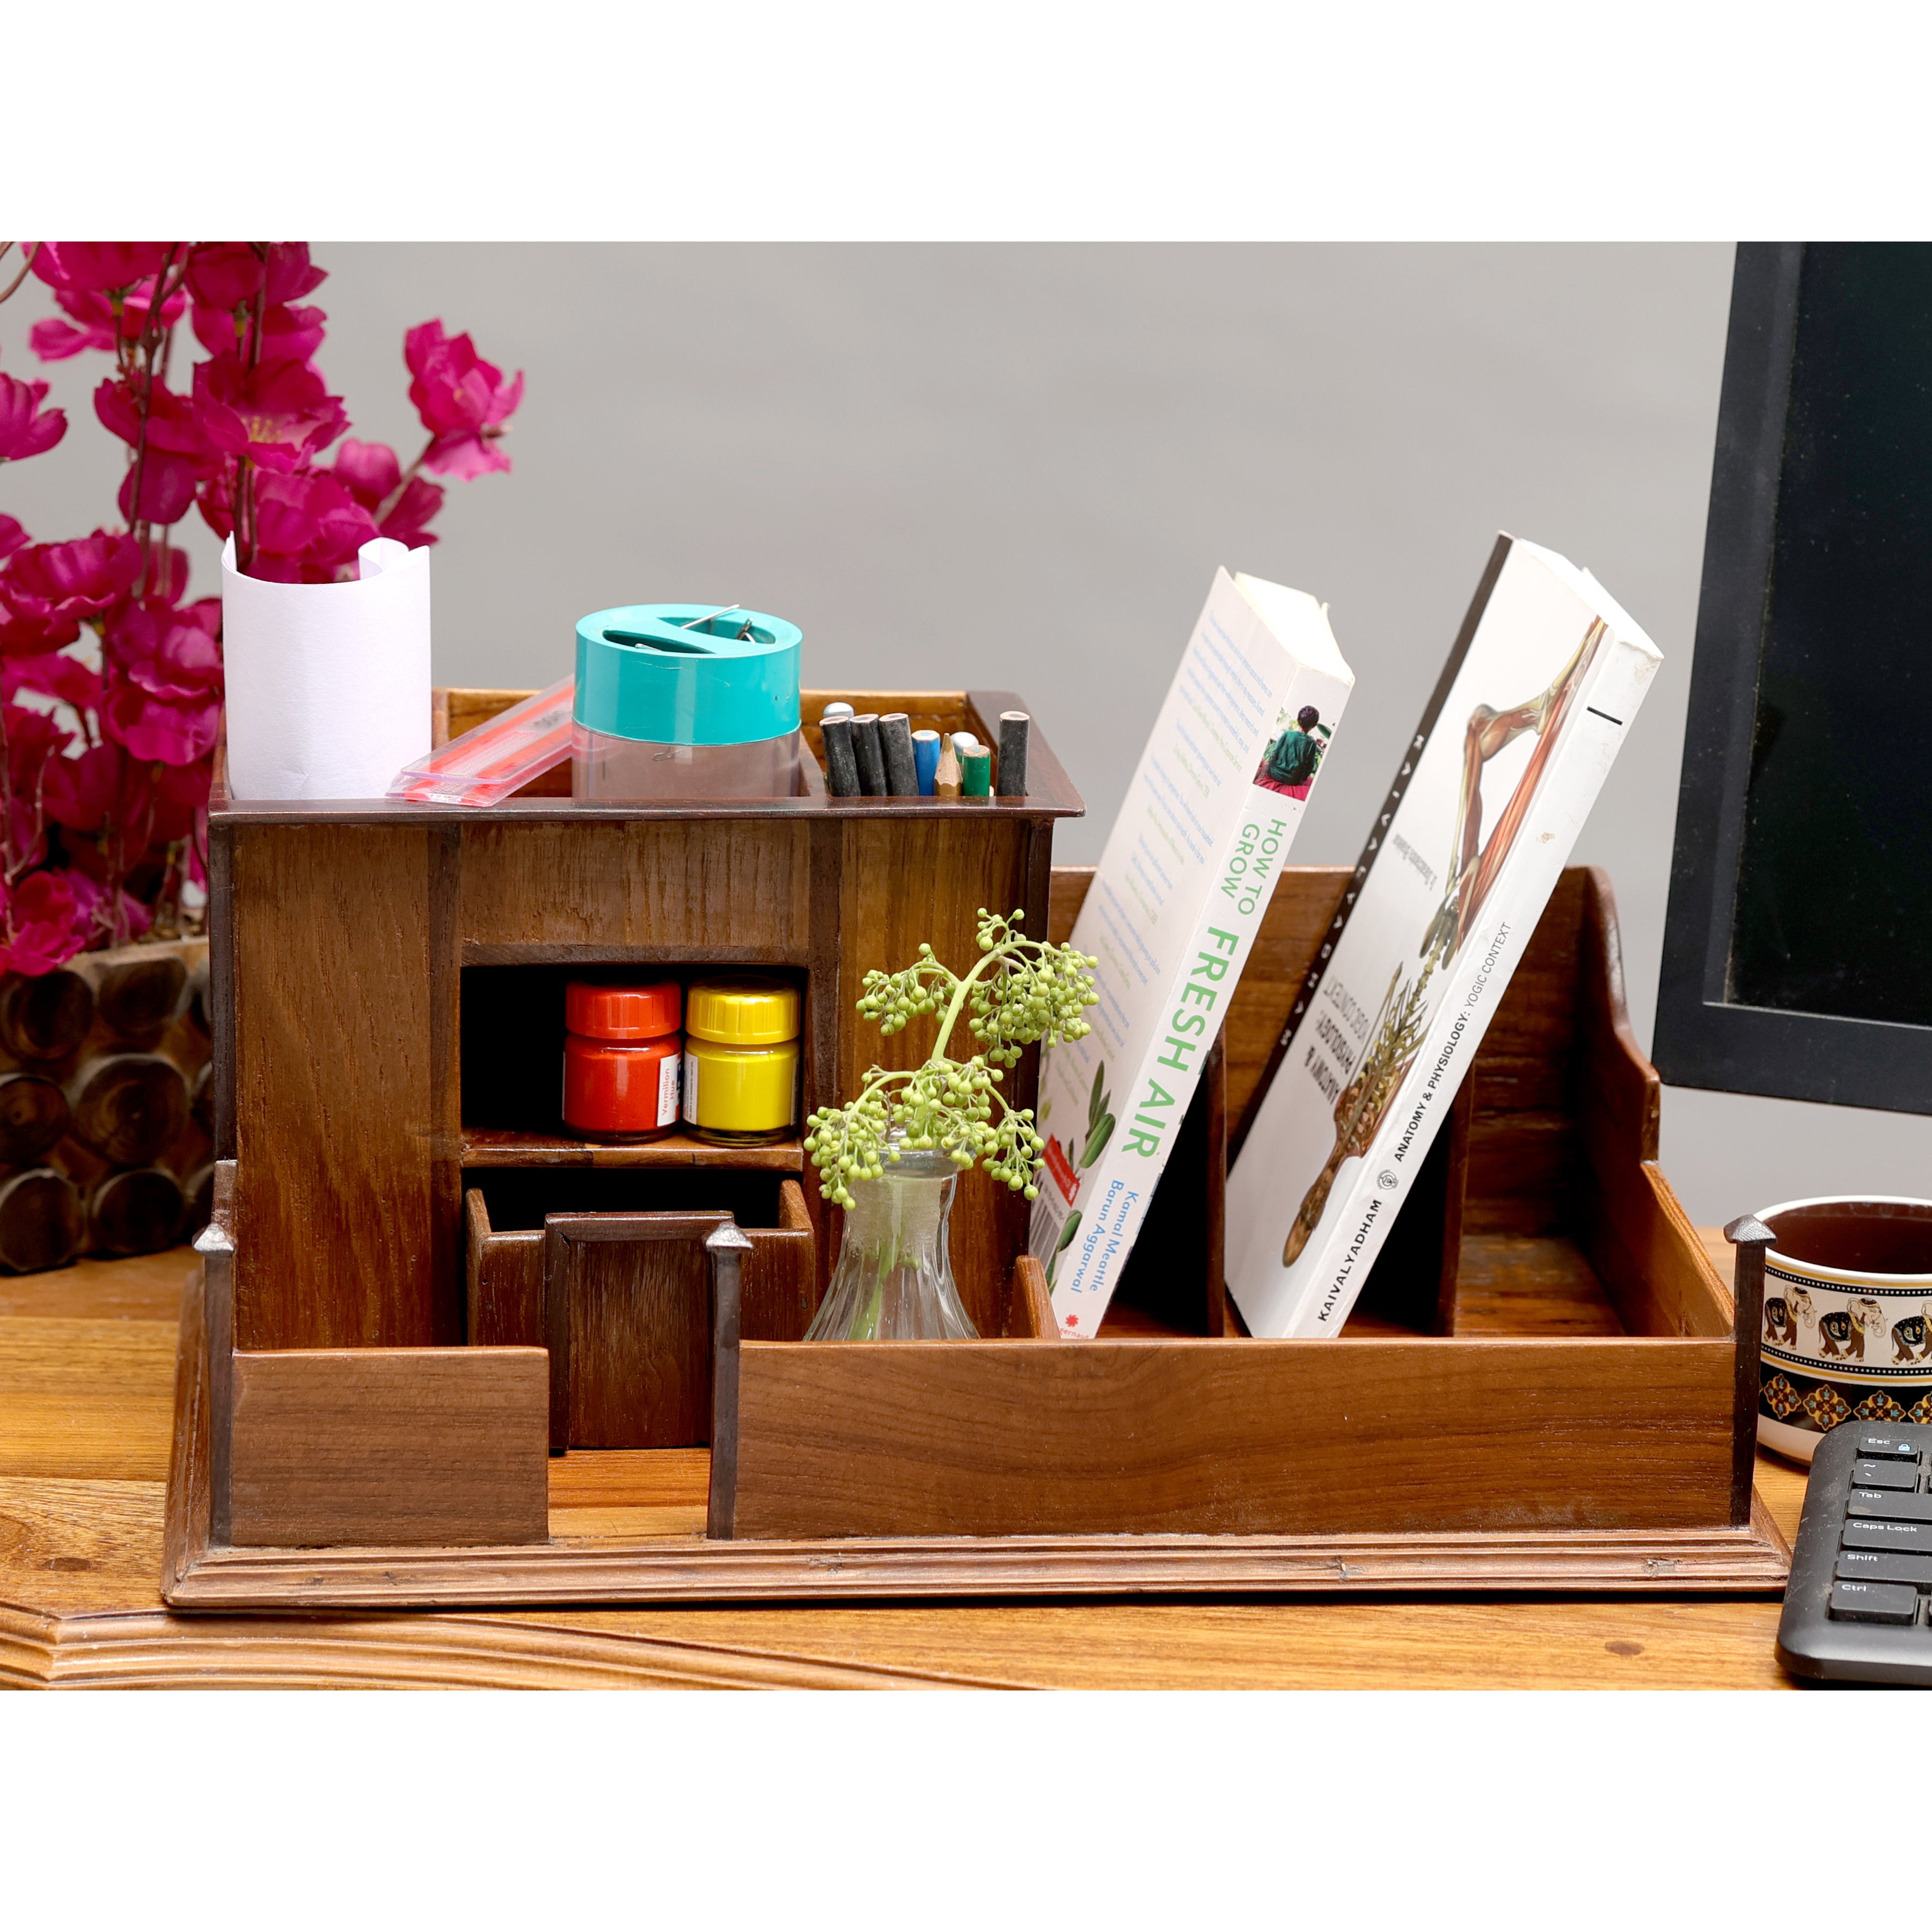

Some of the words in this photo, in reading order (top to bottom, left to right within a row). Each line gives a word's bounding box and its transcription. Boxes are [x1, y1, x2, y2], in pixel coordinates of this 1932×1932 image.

[1221, 824, 1260, 899] GROW
[1253, 819, 1287, 879] HOW
[1238, 885, 1263, 914] TO
[1157, 926, 1239, 1072] FRESH
[1394, 1101, 1427, 1162] ANATOMY
[1422, 1092, 1433, 1102] &
[1428, 1011, 1471, 1090] PHYSIOLOGY:
[1464, 975, 1487, 1008] YOGIC
[1482, 921, 1511, 974] CONTEXT
[1122, 1078, 1176, 1158] AIR
[1098, 1180, 1125, 1221] Barun
[1111, 1191, 1139, 1237] Kamal
[1071, 1223, 1106, 1293] Aggarwal
[1090, 1239, 1121, 1292] Meattle
[1318, 1199, 1382, 1322] KAIVALYADHAM
[1853, 1522, 1884, 1530] Caps
[1847, 1554, 1878, 1562] Shift
[1841, 1584, 1867, 1592] Ctrl
